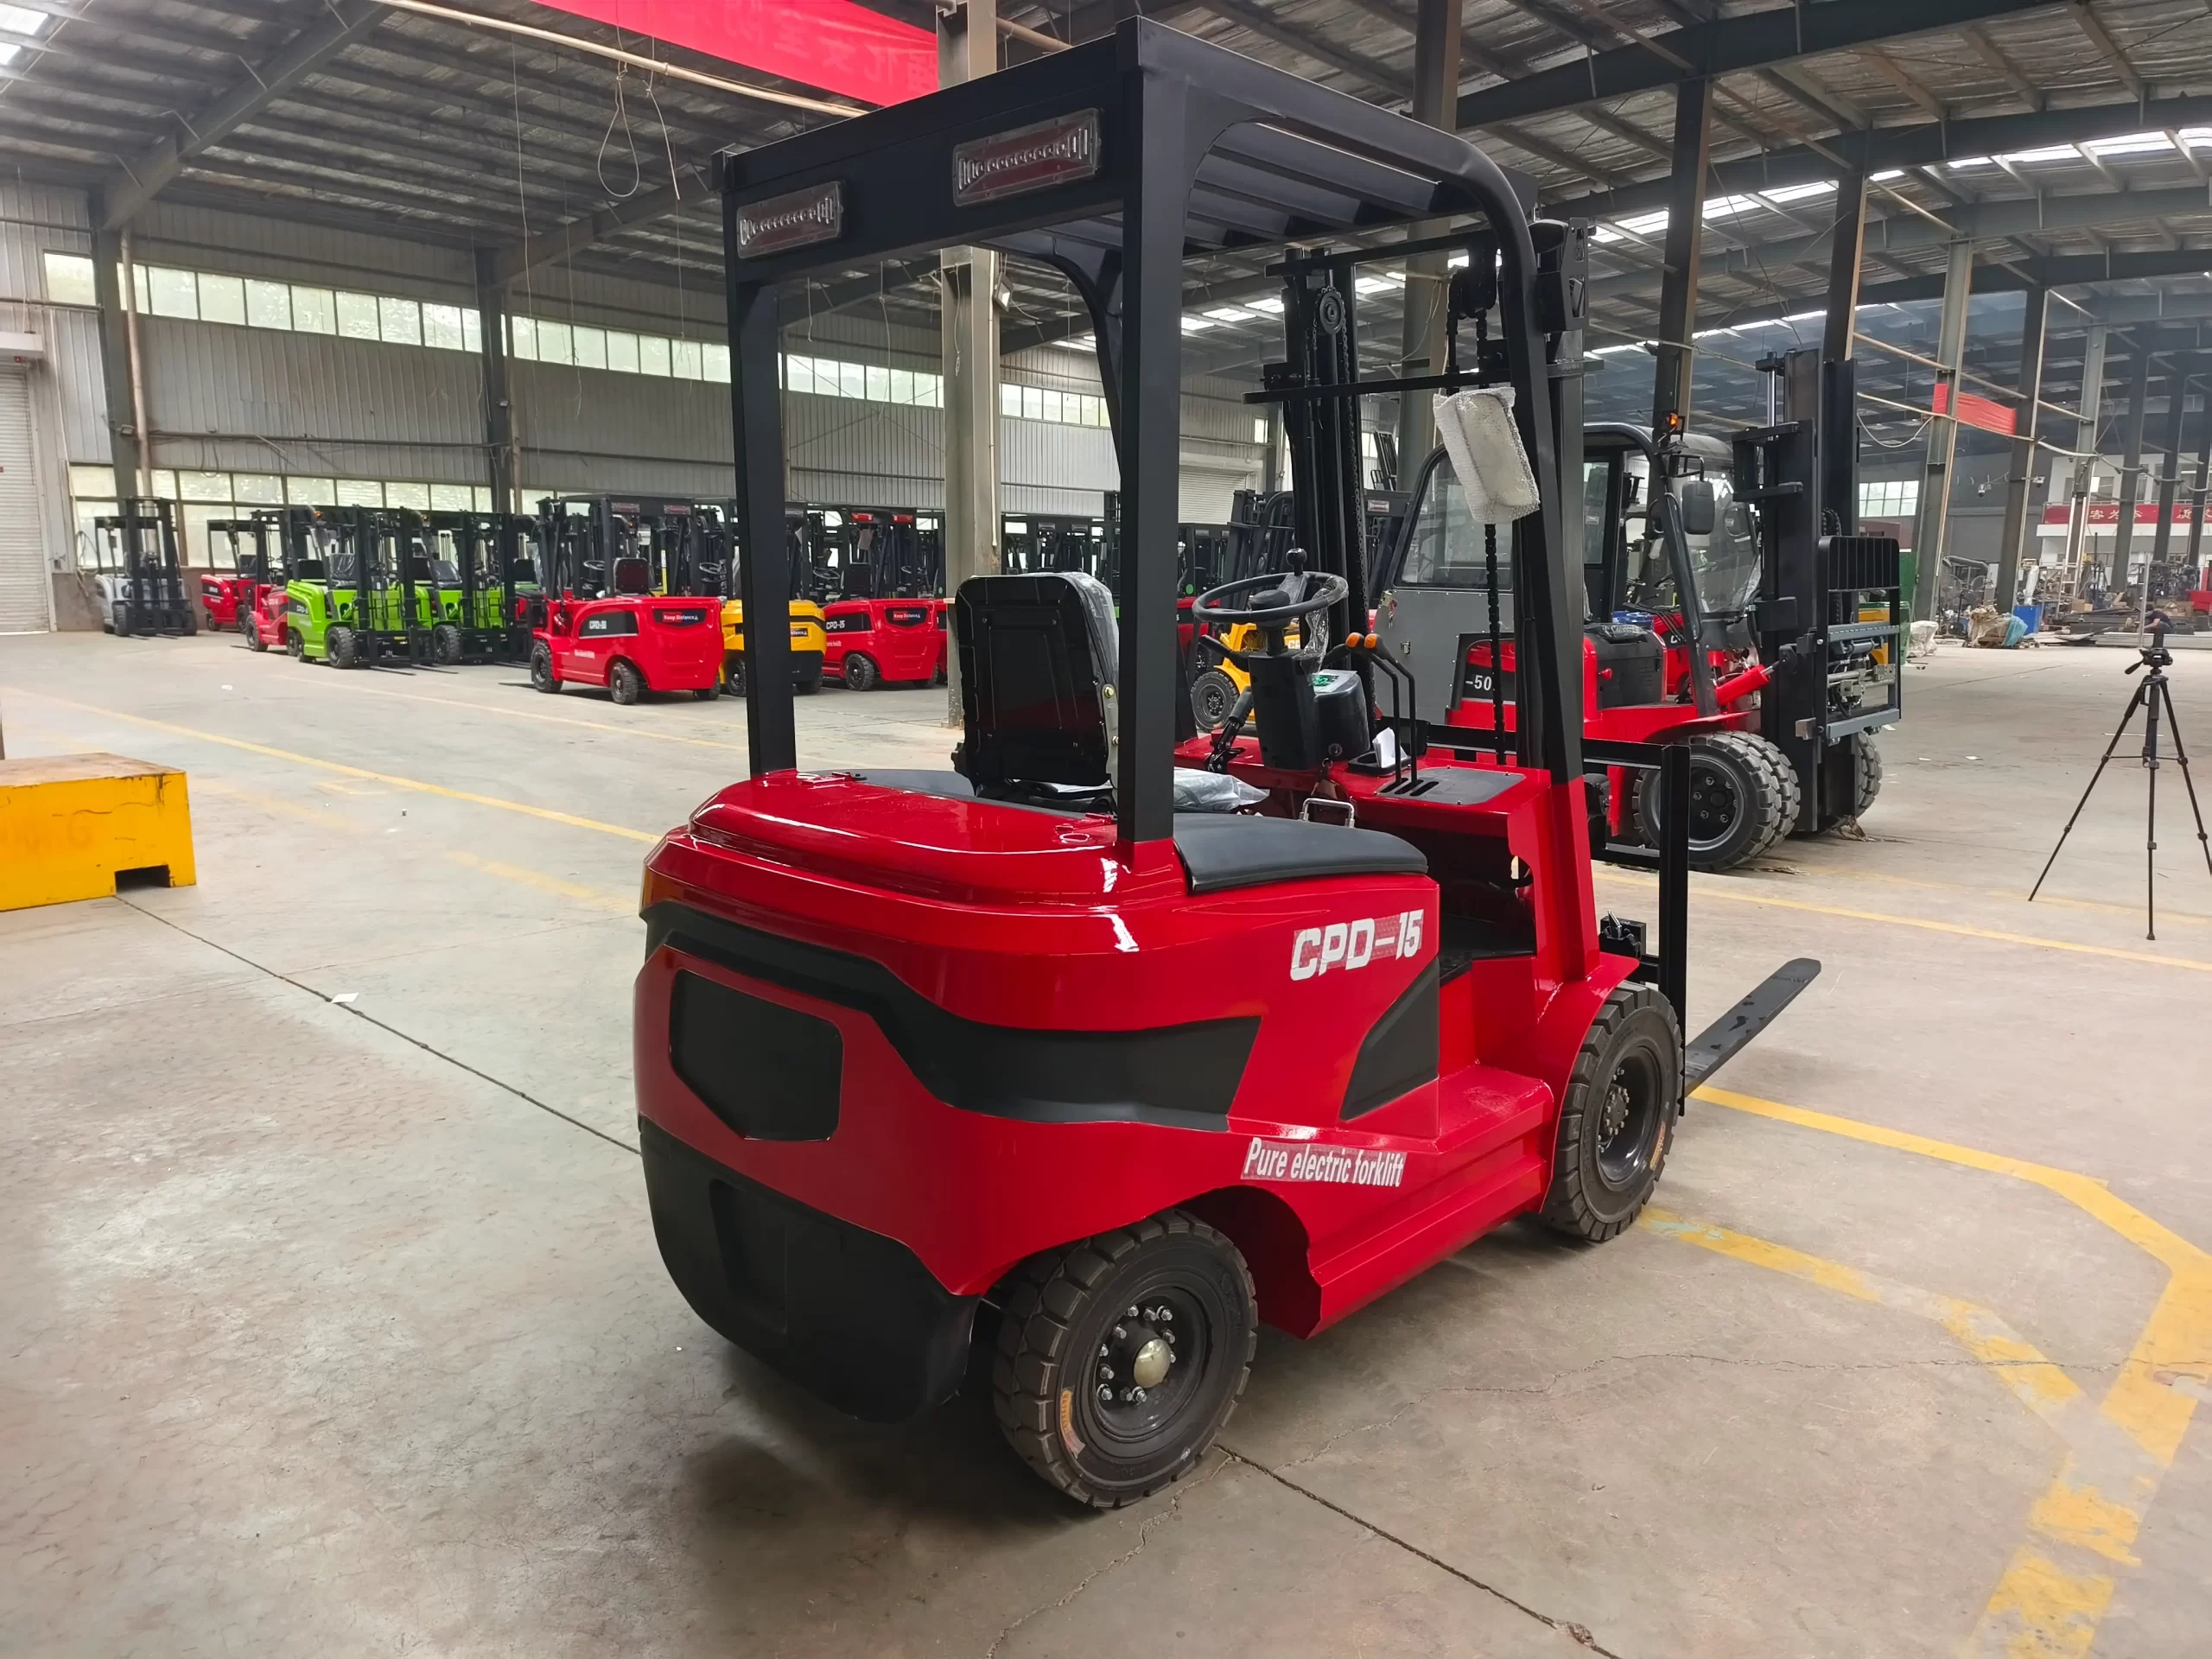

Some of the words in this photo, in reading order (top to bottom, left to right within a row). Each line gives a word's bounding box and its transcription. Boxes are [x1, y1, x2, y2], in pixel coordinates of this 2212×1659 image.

[1290, 909, 1424, 981] CPD-15
[1244, 1137, 1287, 1177] Pure
[1290, 1143, 1351, 1183] electric
[1352, 1149, 1404, 1187] forklift
